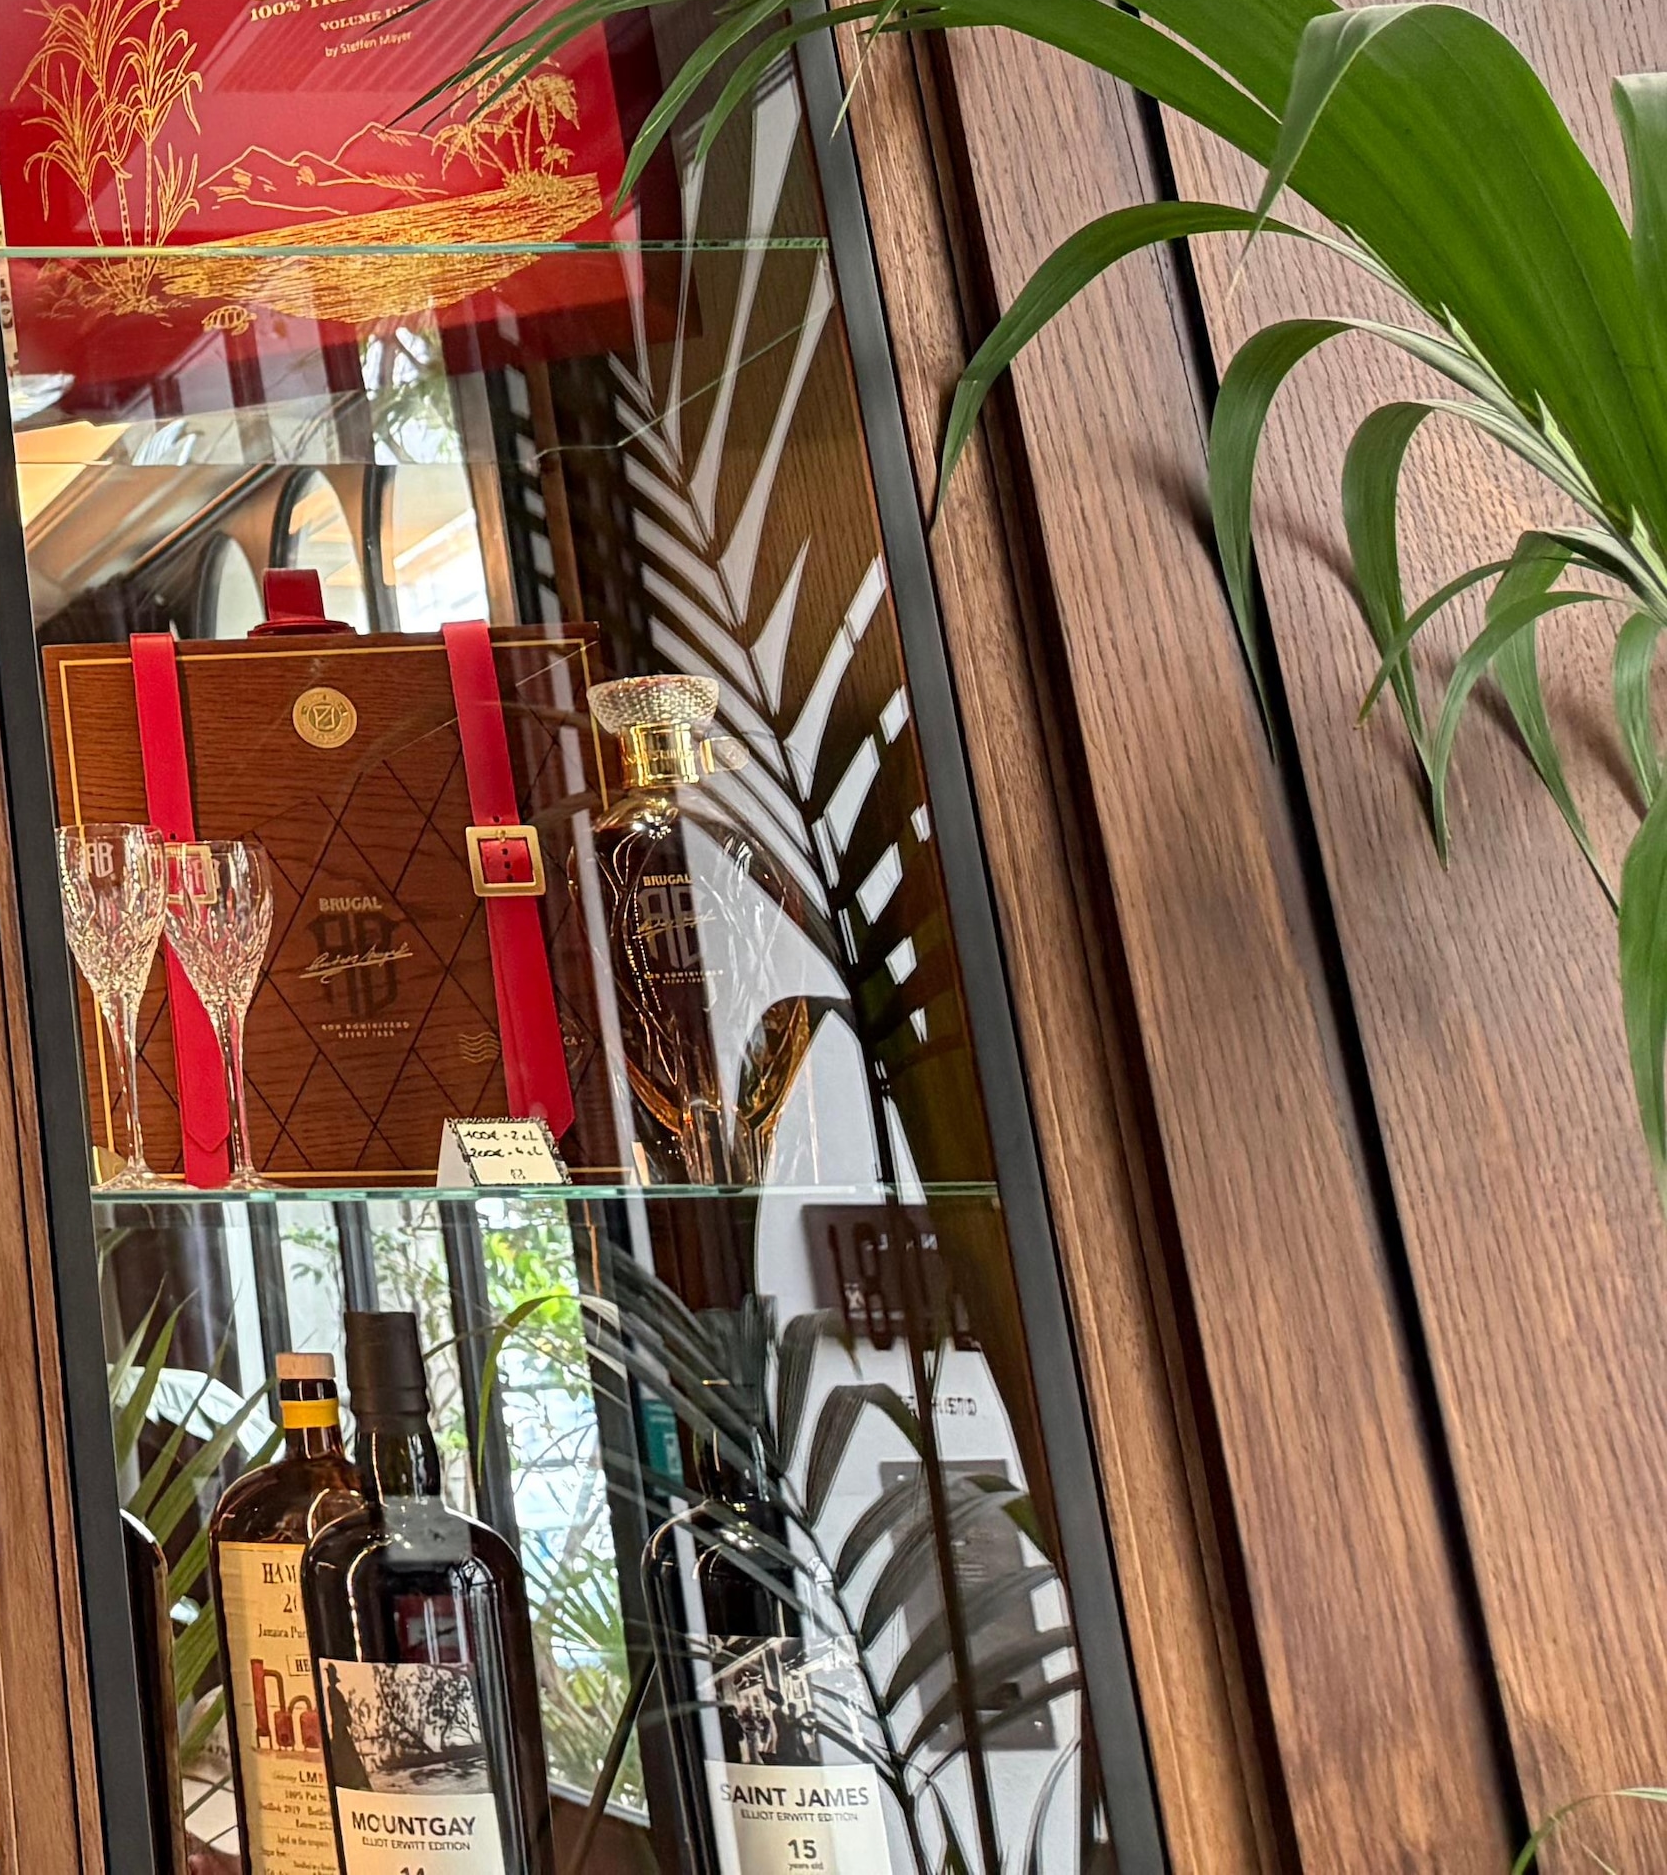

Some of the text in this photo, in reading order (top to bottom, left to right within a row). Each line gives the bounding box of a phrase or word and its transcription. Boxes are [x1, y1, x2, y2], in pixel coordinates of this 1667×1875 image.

[320, 10, 382, 32] VOLUME
[324, 44, 338, 59] by
[643, 874, 693, 887] BRUGAL
[318, 896, 383, 913] BRUGAL
[720, 1783, 870, 1808] SAINT JAMES
[352, 1811, 476, 1837] MOUNTGAY
[428, 1841, 471, 1851] EDITION
[787, 1838, 817, 1860] 15
